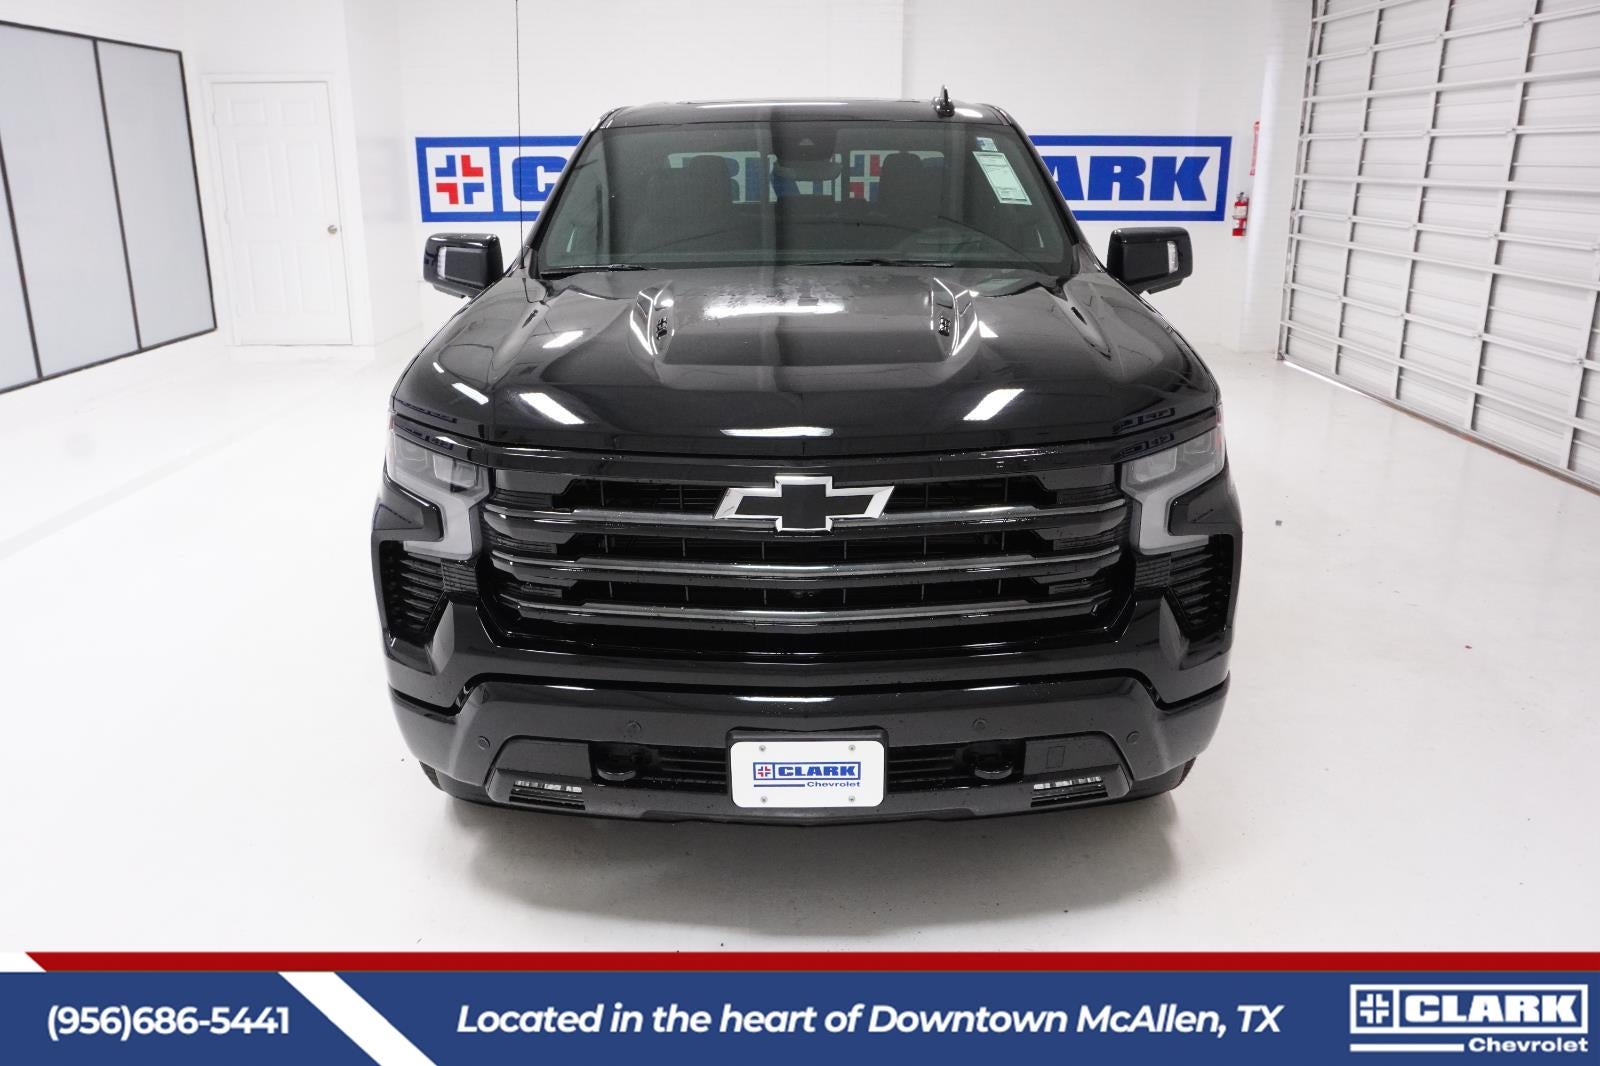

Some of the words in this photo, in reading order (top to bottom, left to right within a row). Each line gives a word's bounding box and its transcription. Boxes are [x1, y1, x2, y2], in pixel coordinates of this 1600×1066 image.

[1041, 154, 1210, 202] ARK
[777, 765, 856, 777] CLARK
[806, 780, 861, 788] Chevrolet
